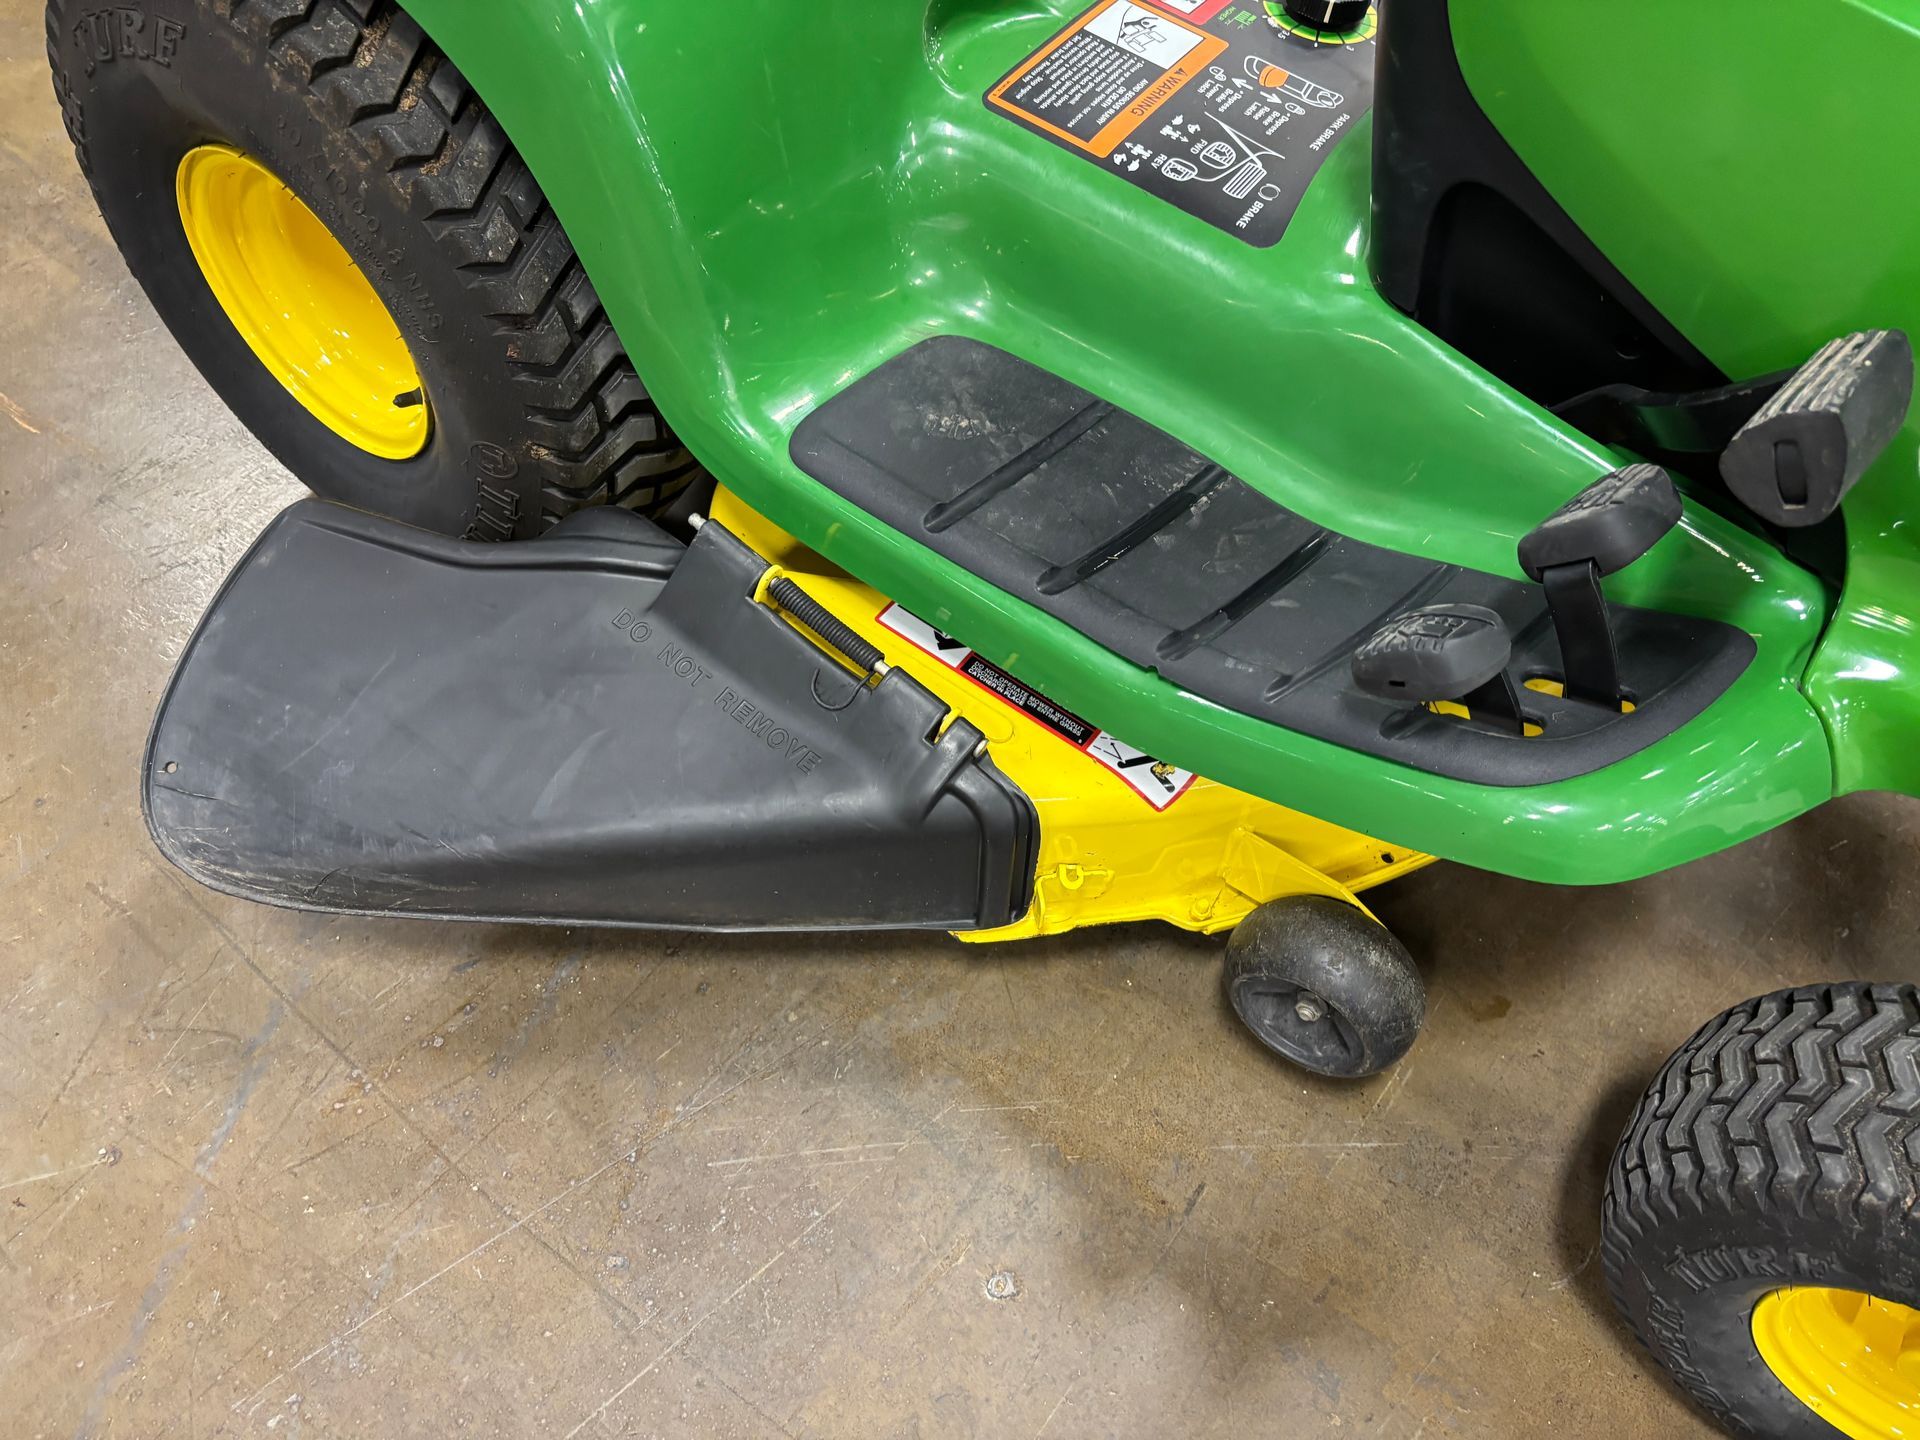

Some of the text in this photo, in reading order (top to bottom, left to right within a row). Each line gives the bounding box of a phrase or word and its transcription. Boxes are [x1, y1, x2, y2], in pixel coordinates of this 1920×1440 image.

[72, 5, 187, 77] TURF
[1078, 38, 1091, 47] When
[1085, 41, 1098, 51] Read
[1061, 47, 1079, 60] leaving
[1100, 48, 1113, 58] Keep
[1109, 52, 1120, 60] stop
[1031, 61, 1050, 76] Remove
[1087, 57, 1102, 68] safety
[1106, 58, 1123, 73] machine
[1122, 59, 1135, 70] Avoid
[1130, 63, 1143, 73] Drive
[1060, 70, 1073, 81] place
[1072, 68, 1089, 81] devices
[1080, 76, 1092, 85] back
[1094, 72, 1107, 83] stops
[1107, 69, 1123, 82] sudden
[1116, 77, 1125, 85] and
[1068, 84, 1081, 95] down
[1080, 82, 1095, 94] going
[1105, 84, 1117, 94] down
[1198, 80, 1214, 93] Latch
[1206, 84, 1223, 98] Lower
[1097, 79, 1148, 125] AVOID SERIOUS INJURY
[1101, 86, 1126, 108] OR DEATH
[1132, 77, 1180, 116] WARNING
[1216, 88, 1233, 102] Brake
[1219, 91, 1241, 112] Depress
[1244, 102, 1261, 116] Latch
[1253, 106, 1270, 120] Raise
[1263, 111, 1280, 126] Brake
[1266, 114, 1289, 135] Depress
[1310, 114, 1350, 151] PARK BRAKE
[1191, 139, 1207, 154] FWD
[1152, 154, 1167, 169] REV
[1236, 201, 1264, 228] BRAKE
[611, 607, 822, 776] DO NOT REMOVE
[968, 669, 996, 688] CATCHER
[1004, 691, 1024, 706] PLACE
[971, 665, 1081, 736] DISCHARGE CHUTE OR ENTIRE GRASS
[974, 661, 1084, 732] DO NOT OPERATE MOWER WITHOUT
